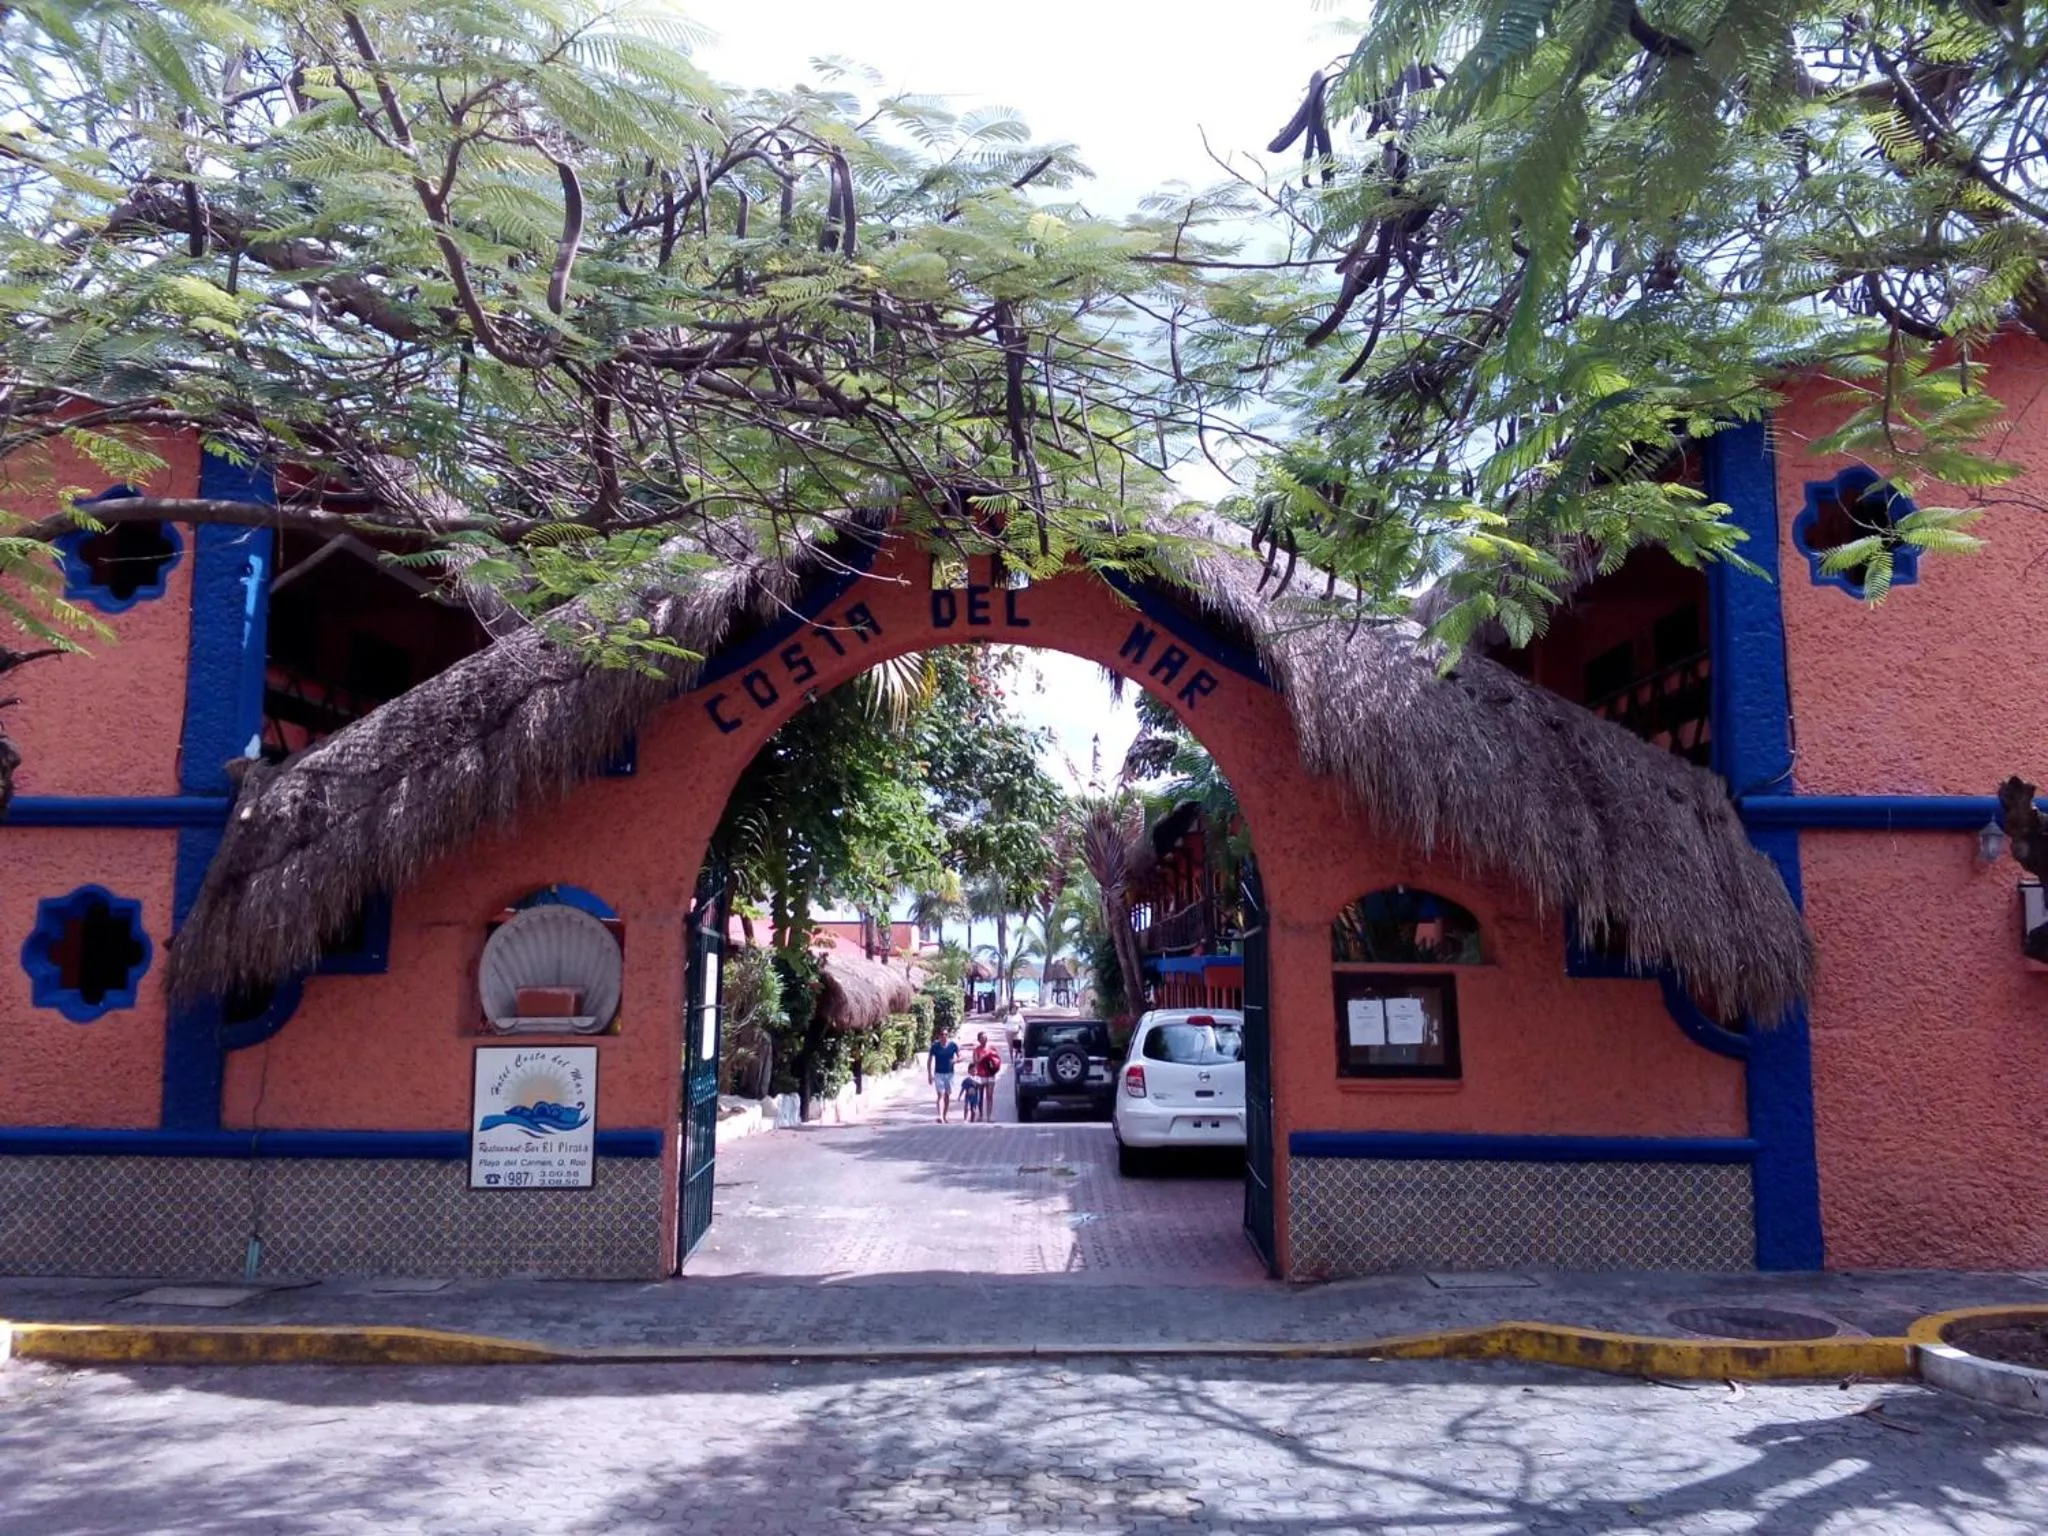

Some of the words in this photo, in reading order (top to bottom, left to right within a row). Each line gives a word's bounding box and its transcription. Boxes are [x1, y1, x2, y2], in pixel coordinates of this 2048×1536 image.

[702, 600, 882, 735] COSTA
[930, 586, 1030, 629] DEL
[1120, 621, 1219, 710] MAR
[514, 1052, 546, 1068] Costa
[551, 1055, 570, 1068] del
[542, 1142, 553, 1153] El
[558, 1142, 589, 1153] Pirata
[479, 1158, 500, 1167] Playa
[504, 1158, 517, 1166] del
[503, 1171, 533, 1186] (987)
